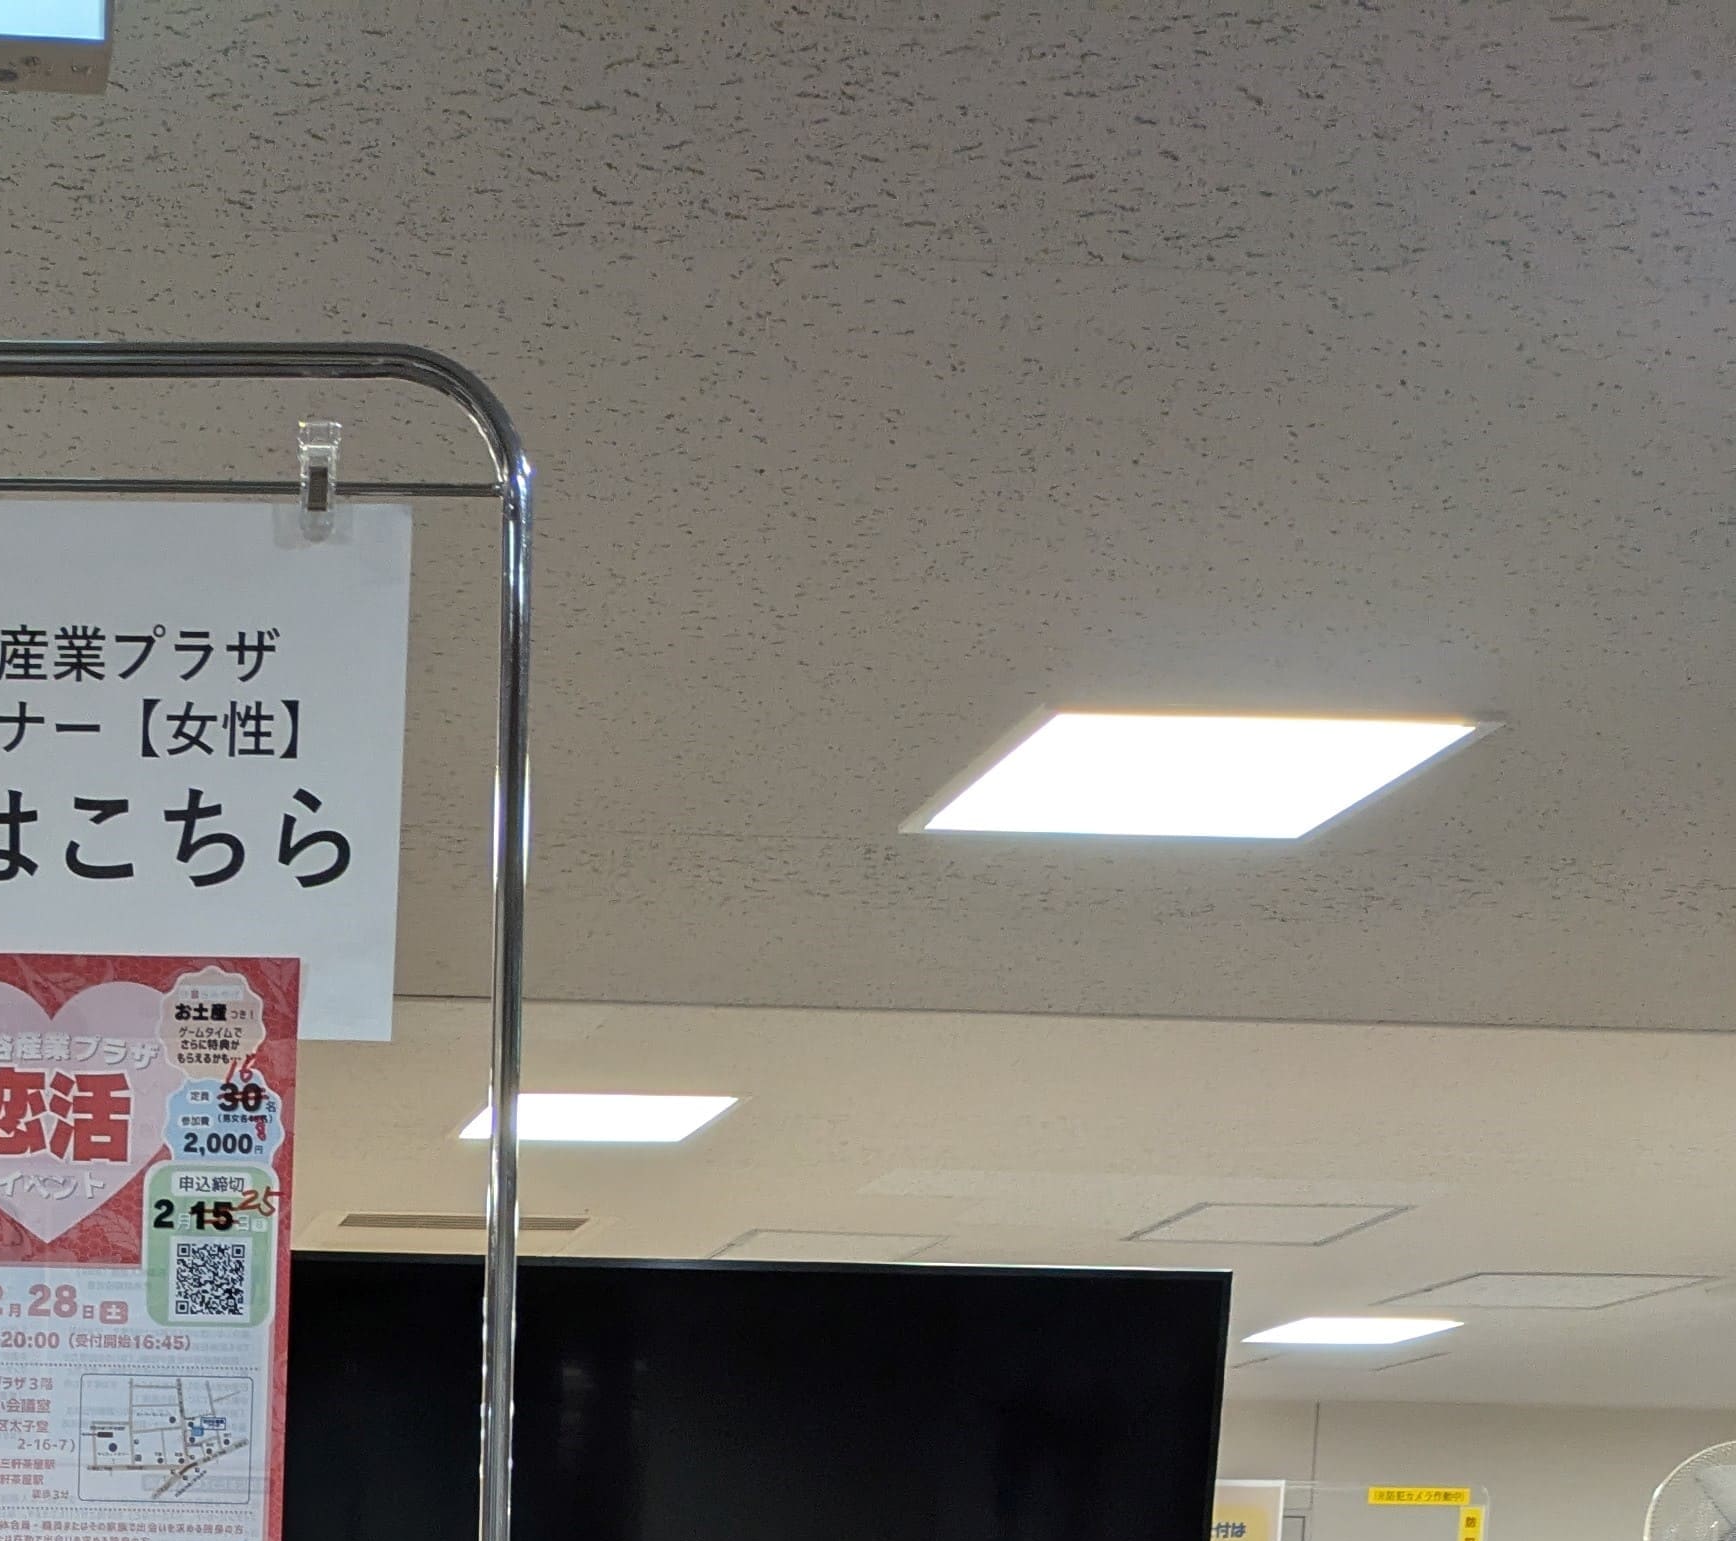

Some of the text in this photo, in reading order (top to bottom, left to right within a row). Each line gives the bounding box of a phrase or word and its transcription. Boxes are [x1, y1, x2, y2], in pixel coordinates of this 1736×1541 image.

[175, 1003, 227, 1021] お土産
[179, 1027, 242, 1038] ゲームタイムで
[181, 1040, 240, 1050] さらに特典が
[190, 1092, 210, 1101] 定員
[181, 1117, 210, 1126] 参加費
[179, 1177, 245, 1192] 申込締切
[1212, 1522, 1246, 1538] 付は
